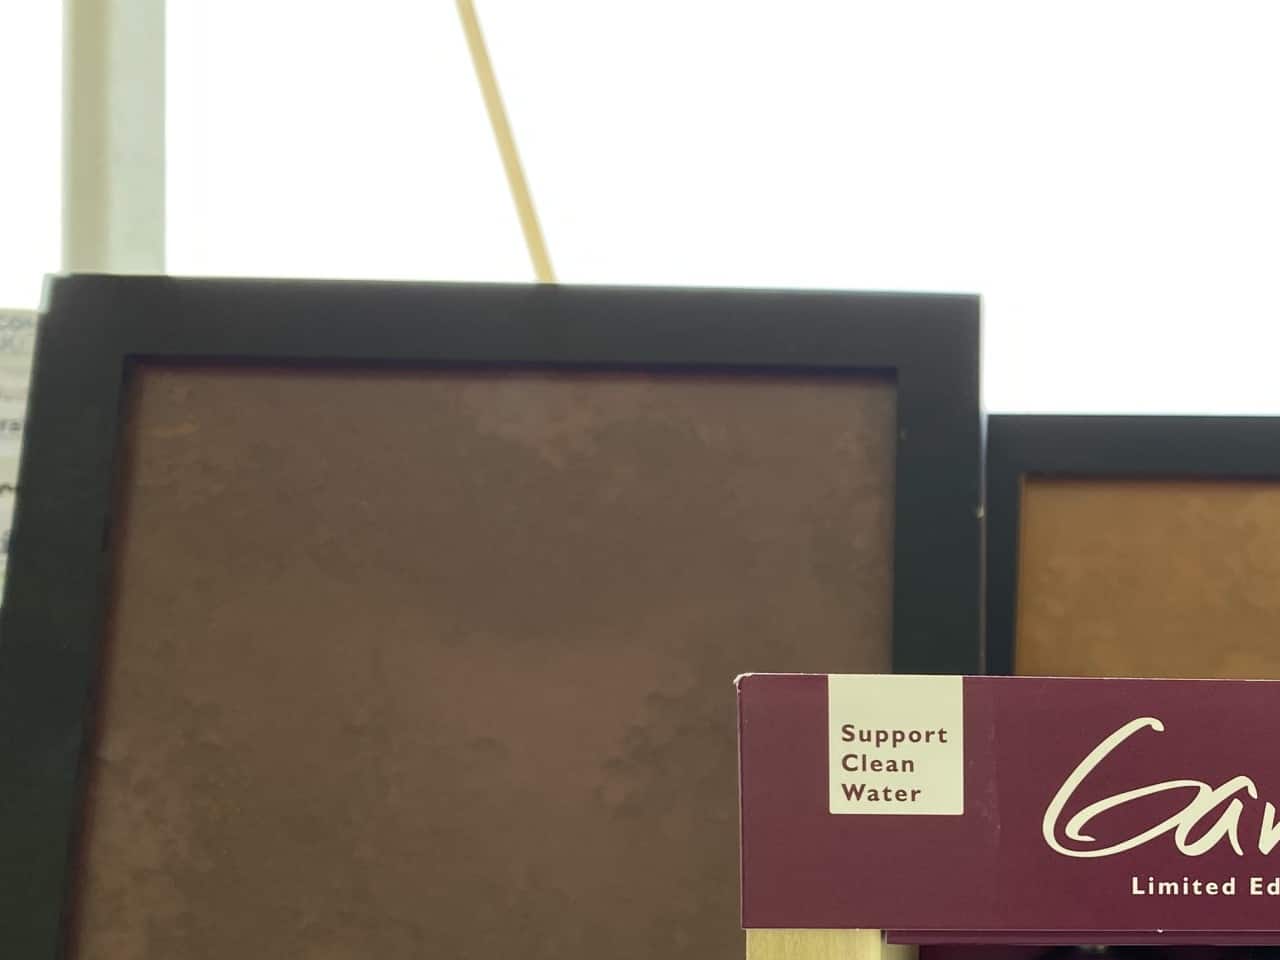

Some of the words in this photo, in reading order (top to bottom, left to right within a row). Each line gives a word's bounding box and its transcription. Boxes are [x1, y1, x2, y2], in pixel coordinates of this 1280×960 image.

[841, 723, 948, 747] Support
[841, 753, 915, 774] Clean
[841, 782, 922, 802] Water
[1131, 876, 1236, 896] Limited
